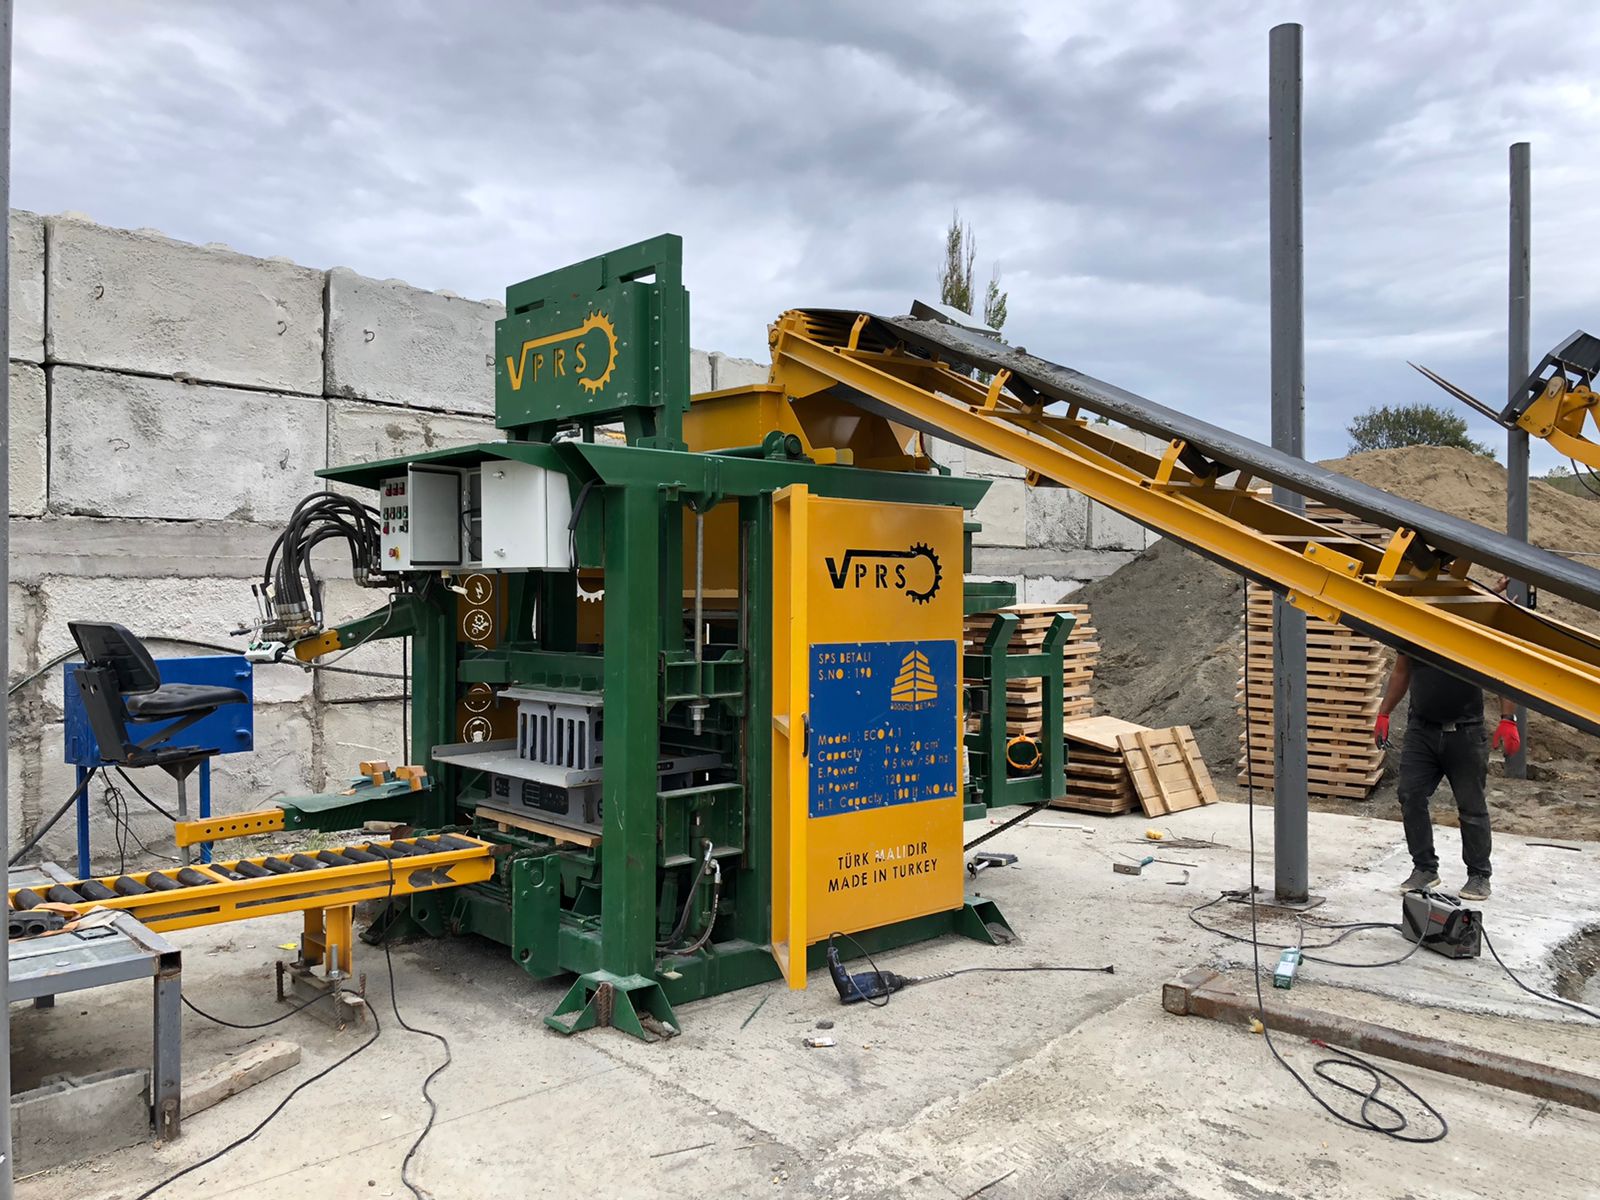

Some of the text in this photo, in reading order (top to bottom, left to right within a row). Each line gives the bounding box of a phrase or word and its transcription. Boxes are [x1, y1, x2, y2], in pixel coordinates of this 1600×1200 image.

[818, 651, 872, 665] SPS BETALI
[854, 667, 873, 679] 190
[818, 732, 851, 746] Model
[863, 728, 886, 742] ECO
[910, 740, 921, 752] 20
[925, 754, 936, 766] 50
[885, 773, 902, 786] 120
[893, 787, 910, 801] 100
[838, 852, 869, 870] TÜRK
[828, 858, 938, 893] MADE IN TURKEY
